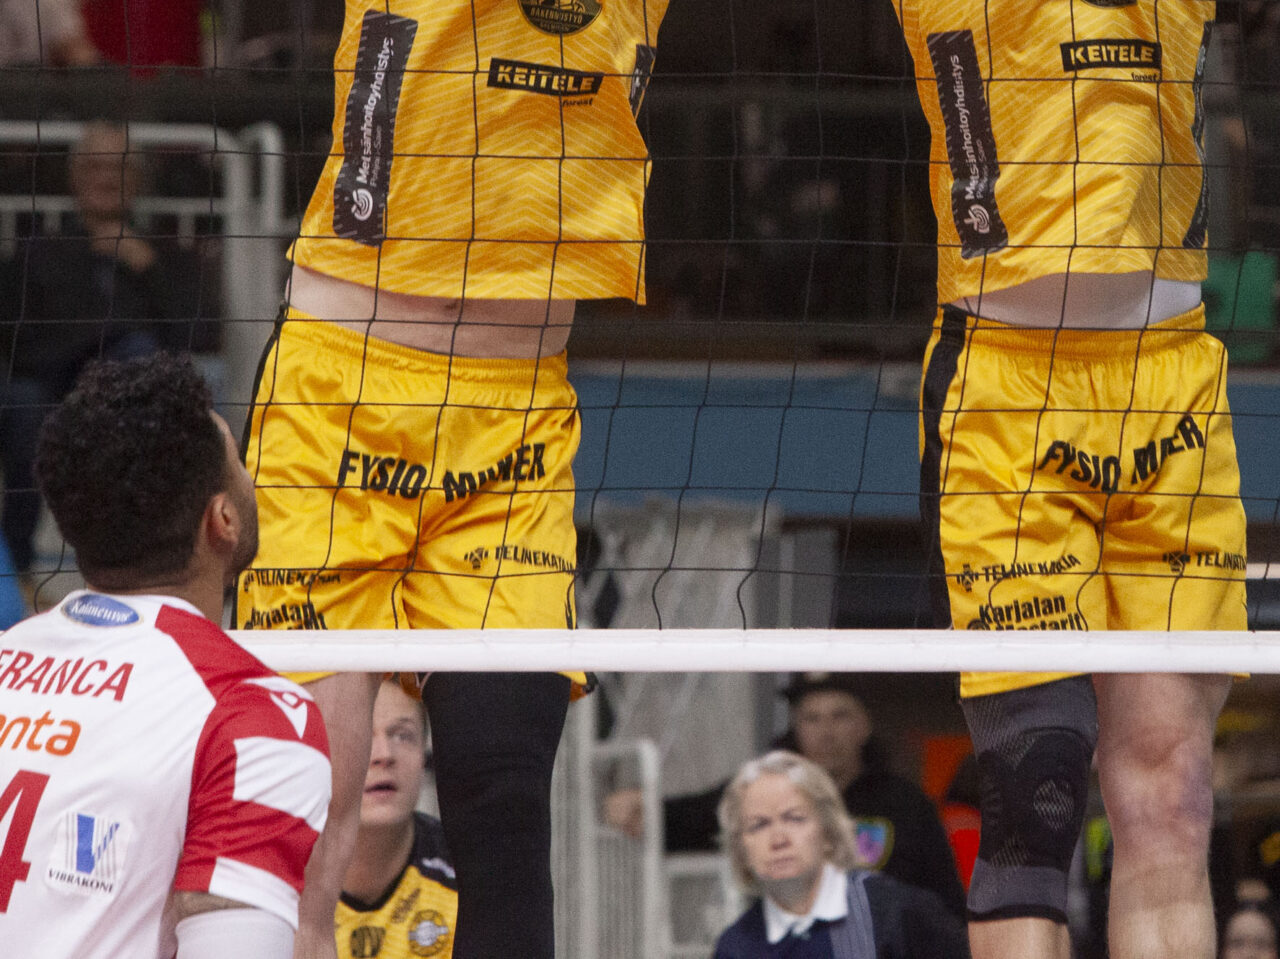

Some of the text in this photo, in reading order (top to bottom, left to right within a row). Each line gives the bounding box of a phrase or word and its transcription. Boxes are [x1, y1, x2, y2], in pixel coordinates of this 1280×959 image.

[1070, 44, 1155, 65] KEITELE
[497, 65, 595, 91] KEITELE
[337, 449, 427, 499] FYSIO
[1037, 440, 1121, 494] FYSIO
[0, 710, 82, 756] nta
